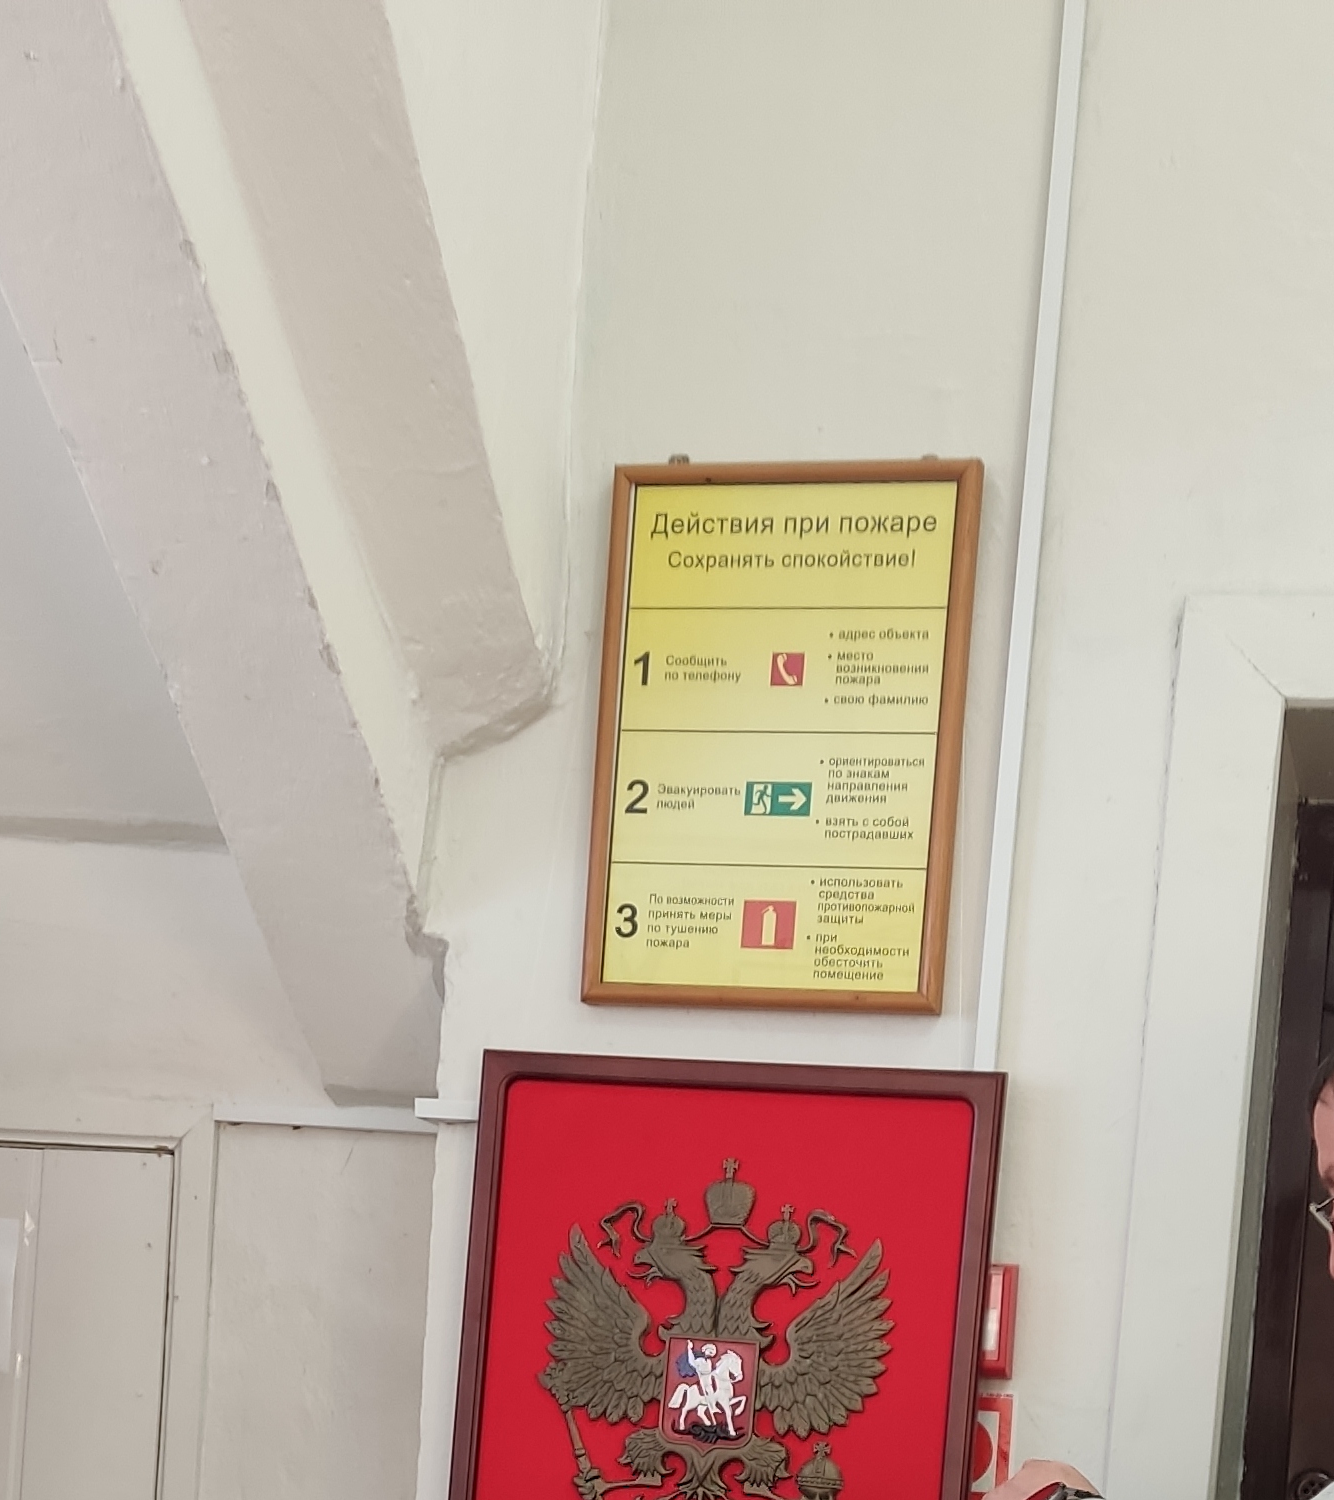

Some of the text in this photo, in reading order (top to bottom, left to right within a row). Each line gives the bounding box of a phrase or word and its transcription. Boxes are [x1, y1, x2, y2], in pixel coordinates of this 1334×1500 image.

[651, 512, 938, 539] Действия при пожаре
[668, 549, 916, 572] Сохранять спокойствие!
[838, 628, 929, 642] адрес объекта
[665, 655, 728, 669] Сообщить
[837, 651, 874, 662] место
[634, 651, 651, 686] 1
[836, 664, 929, 674] возникновения
[664, 669, 742, 685] по телефону
[835, 674, 881, 685] пожара
[833, 693, 929, 707] свою фамилию
[829, 757, 925, 769] ориентироваться
[828, 769, 890, 779] по знакам
[657, 784, 741, 798] Эвакуировать
[827, 781, 908, 793] направления
[624, 779, 649, 814] 2
[826, 793, 887, 805] движения
[656, 798, 695, 811] людей
[825, 816, 910, 828] взять с собой
[824, 829, 914, 841] пострадавших
[819, 877, 903, 889] использовать
[649, 894, 735, 906] По возможности
[818, 890, 875, 902] средства
[817, 901, 916, 914] противопожарной
[615, 903, 638, 938] 3
[648, 910, 732, 924] принять меры
[817, 914, 864, 926] защиты
[647, 924, 719, 936] по тушению
[646, 938, 690, 950] пожара
[815, 933, 838, 945] при
[814, 945, 910, 957] необходимости
[813, 957, 883, 969] обесточить
[812, 969, 884, 982] помещение
